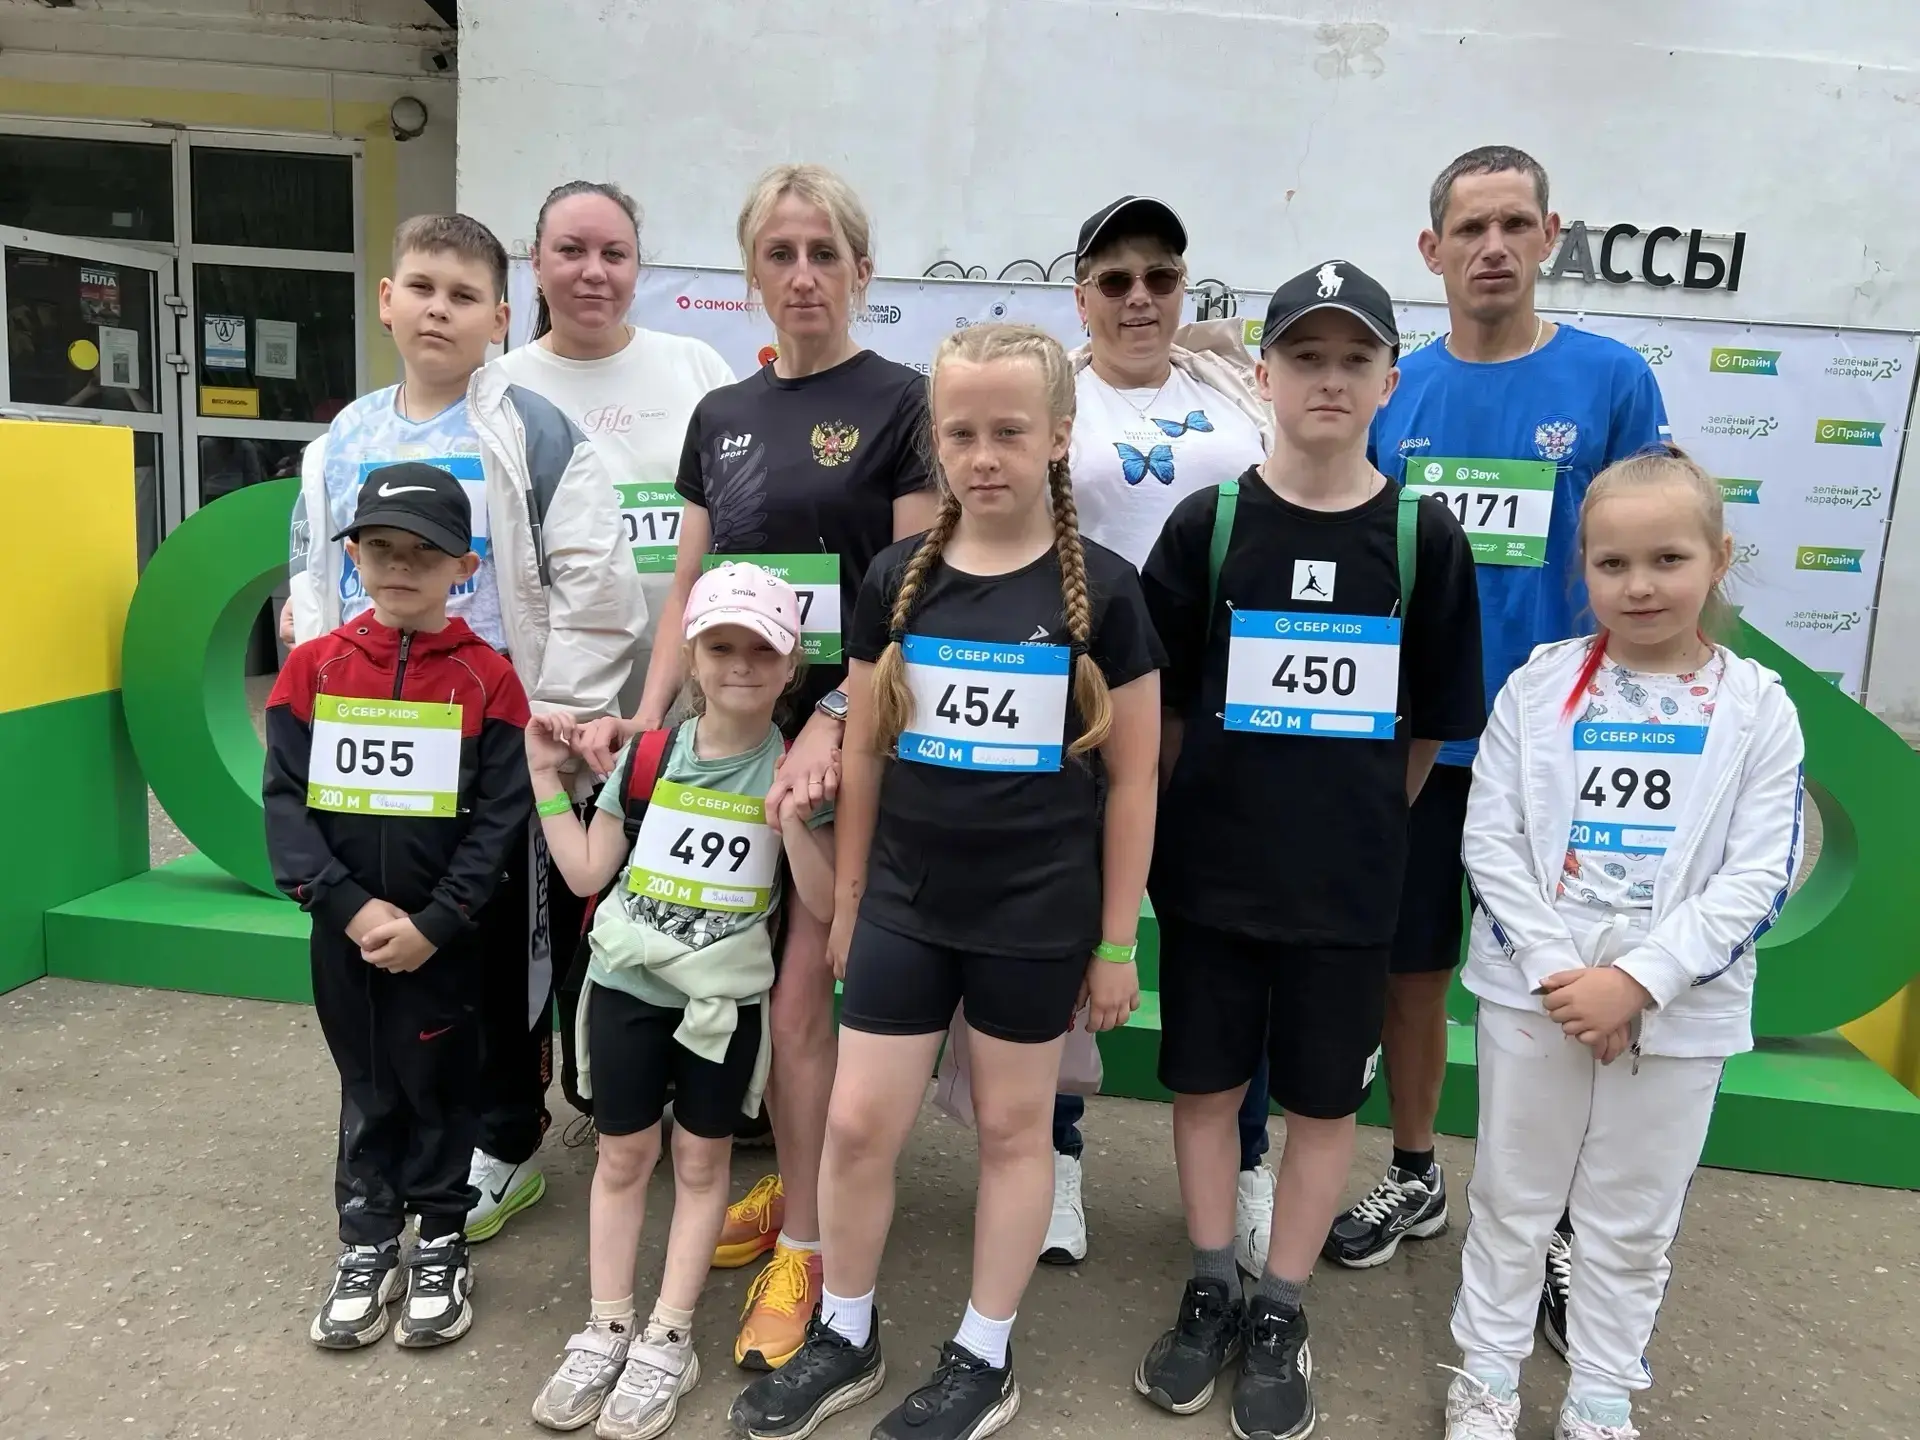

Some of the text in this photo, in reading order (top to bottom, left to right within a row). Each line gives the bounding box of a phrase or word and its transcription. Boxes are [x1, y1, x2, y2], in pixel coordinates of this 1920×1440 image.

[1551, 220, 1747, 292] АССЫ
[81, 273, 117, 287] БПЛА
[1732, 356, 1771, 369] Прайм
[1832, 356, 1878, 368] зелёный
[1825, 367, 1872, 379] марафон
[1708, 414, 1755, 426] зелёный
[1700, 425, 1749, 437] марафон
[1837, 428, 1875, 440] Прайм
[720, 450, 748, 460] SPORT
[1470, 470, 1500, 481] Звук
[650, 491, 677, 502] Звук
[1812, 485, 1858, 496] зелёный
[1805, 495, 1853, 506] марафон
[621, 512, 680, 542] 017
[1506, 542, 1526, 550] 30.05
[1505, 549, 1523, 557] 2026
[1817, 553, 1855, 566] Прайм
[731, 588, 757, 598] Smile
[1793, 610, 1838, 621] зелёный
[1294, 621, 1362, 635] СБЕР KIDS
[1785, 620, 1833, 631] марафон
[803, 640, 822, 649] 30.05
[955, 649, 1025, 664] СБЕР KIDS
[1271, 654, 1357, 696] 450
[935, 683, 1020, 729] 454
[351, 706, 419, 720] СБЕР KIDS
[1249, 709, 1283, 728] 420
[1600, 731, 1675, 744] СБЕР KIDS
[917, 739, 946, 759] 420
[335, 737, 414, 777] 055
[1579, 766, 1671, 811] 498
[319, 789, 344, 806] 200
[697, 796, 760, 815] СБЕР KIDS
[1570, 825, 1590, 843] 20
[669, 827, 751, 873] 499
[645, 876, 675, 896] 200
